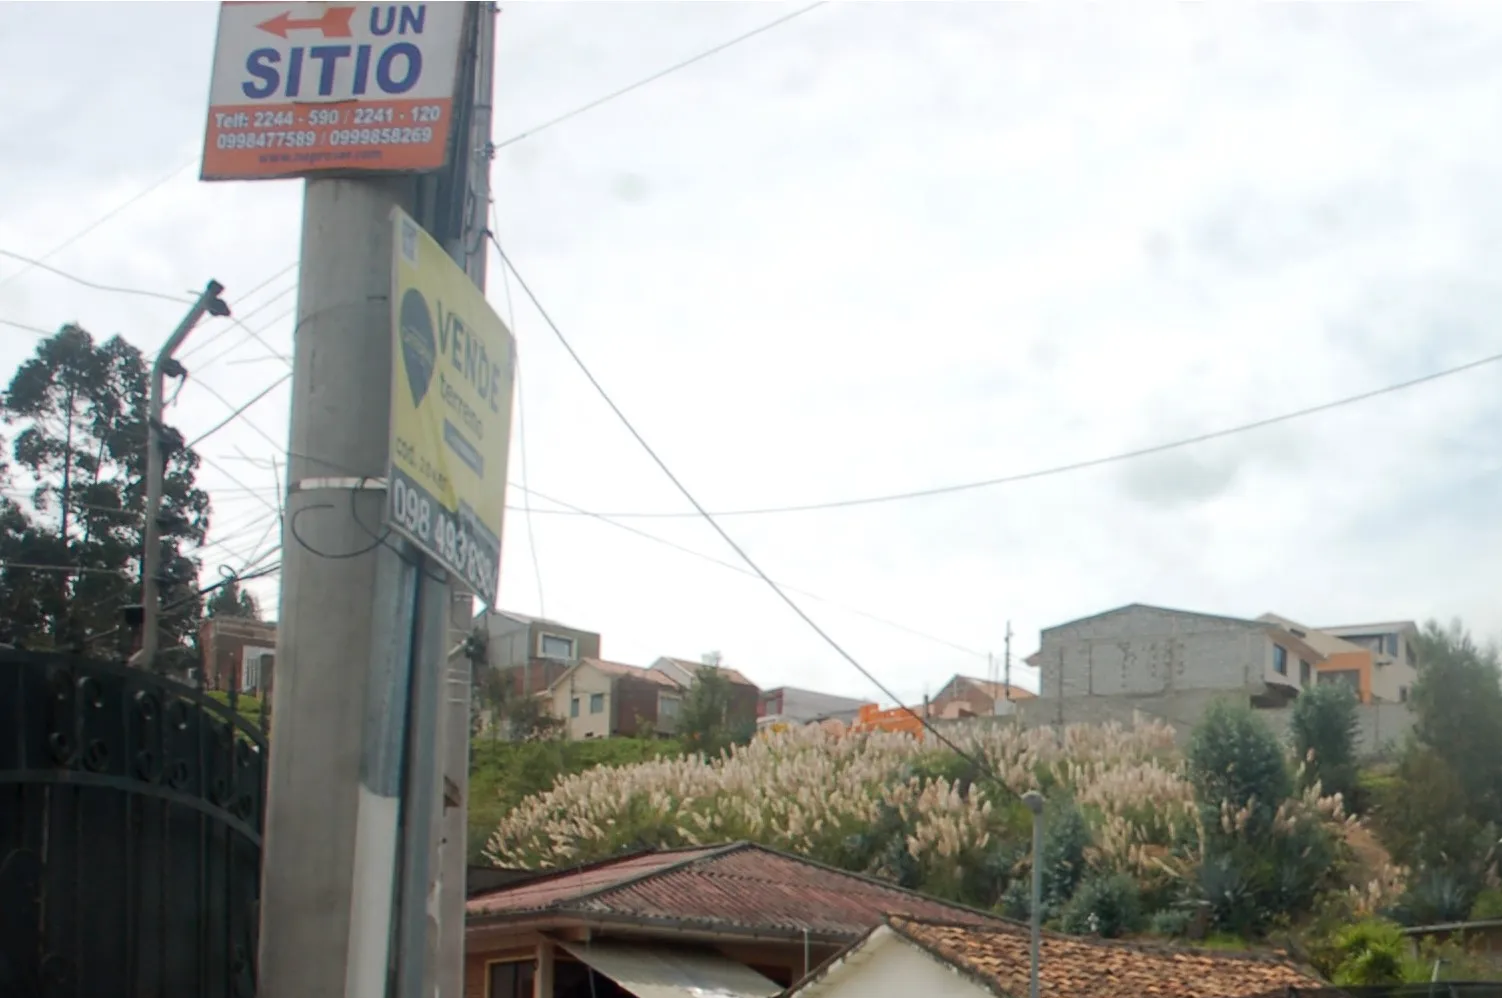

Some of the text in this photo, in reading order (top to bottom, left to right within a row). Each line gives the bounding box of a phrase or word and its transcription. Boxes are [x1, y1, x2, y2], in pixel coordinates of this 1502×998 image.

[370, 5, 425, 36] UN
[241, 42, 423, 99] SITIO
[253, 109, 294, 127] 2244
[308, 108, 339, 126] 590
[353, 107, 393, 124] 2241
[410, 105, 441, 122] 120
[437, 300, 500, 414] VENDE
[393, 478, 431, 542] 098
